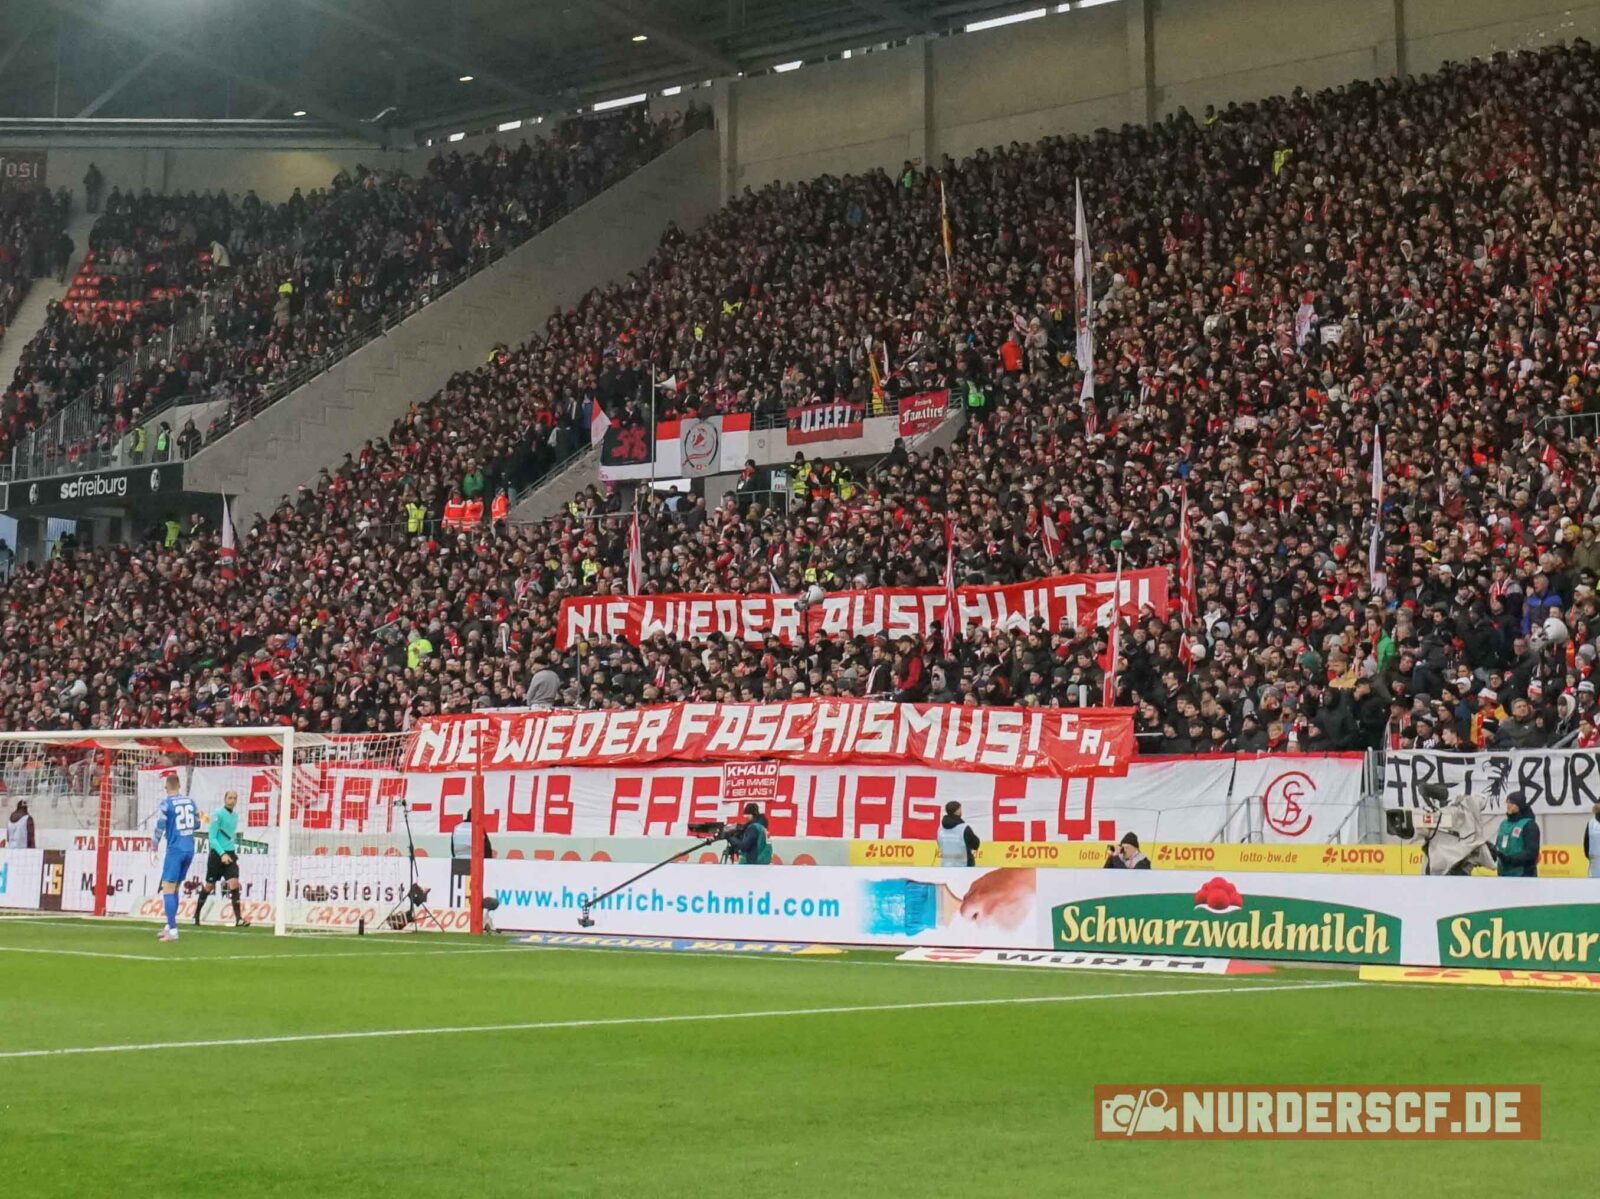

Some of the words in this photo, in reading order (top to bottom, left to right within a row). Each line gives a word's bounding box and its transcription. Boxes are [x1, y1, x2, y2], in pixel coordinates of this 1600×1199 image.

[567, 602, 630, 649] NIE
[640, 598, 801, 644] WIEDER
[822, 577, 1150, 641] AUSCHWITZ!
[411, 717, 488, 767] NIE
[491, 708, 672, 764] WIEDER
[673, 702, 1043, 767] FASCHISMUS!
[727, 765, 777, 777] KHALID
[746, 778, 776, 787] IMMER
[175, 804, 195, 830] 26
[880, 845, 915, 859] LOTTO
[1021, 845, 1059, 860] LOTTO
[1174, 846, 1215, 862] LOTTO
[1239, 847, 1298, 864] lotto-bw.de
[1340, 847, 1385, 864] LOTTO
[42, 863, 64, 895] HS
[495, 885, 841, 918] www.heinrich-schmid.com
[305, 905, 376, 925] CAZOO
[1061, 905, 1391, 955] Schwarzwaldmilch
[1449, 917, 1600, 962] Schwar
